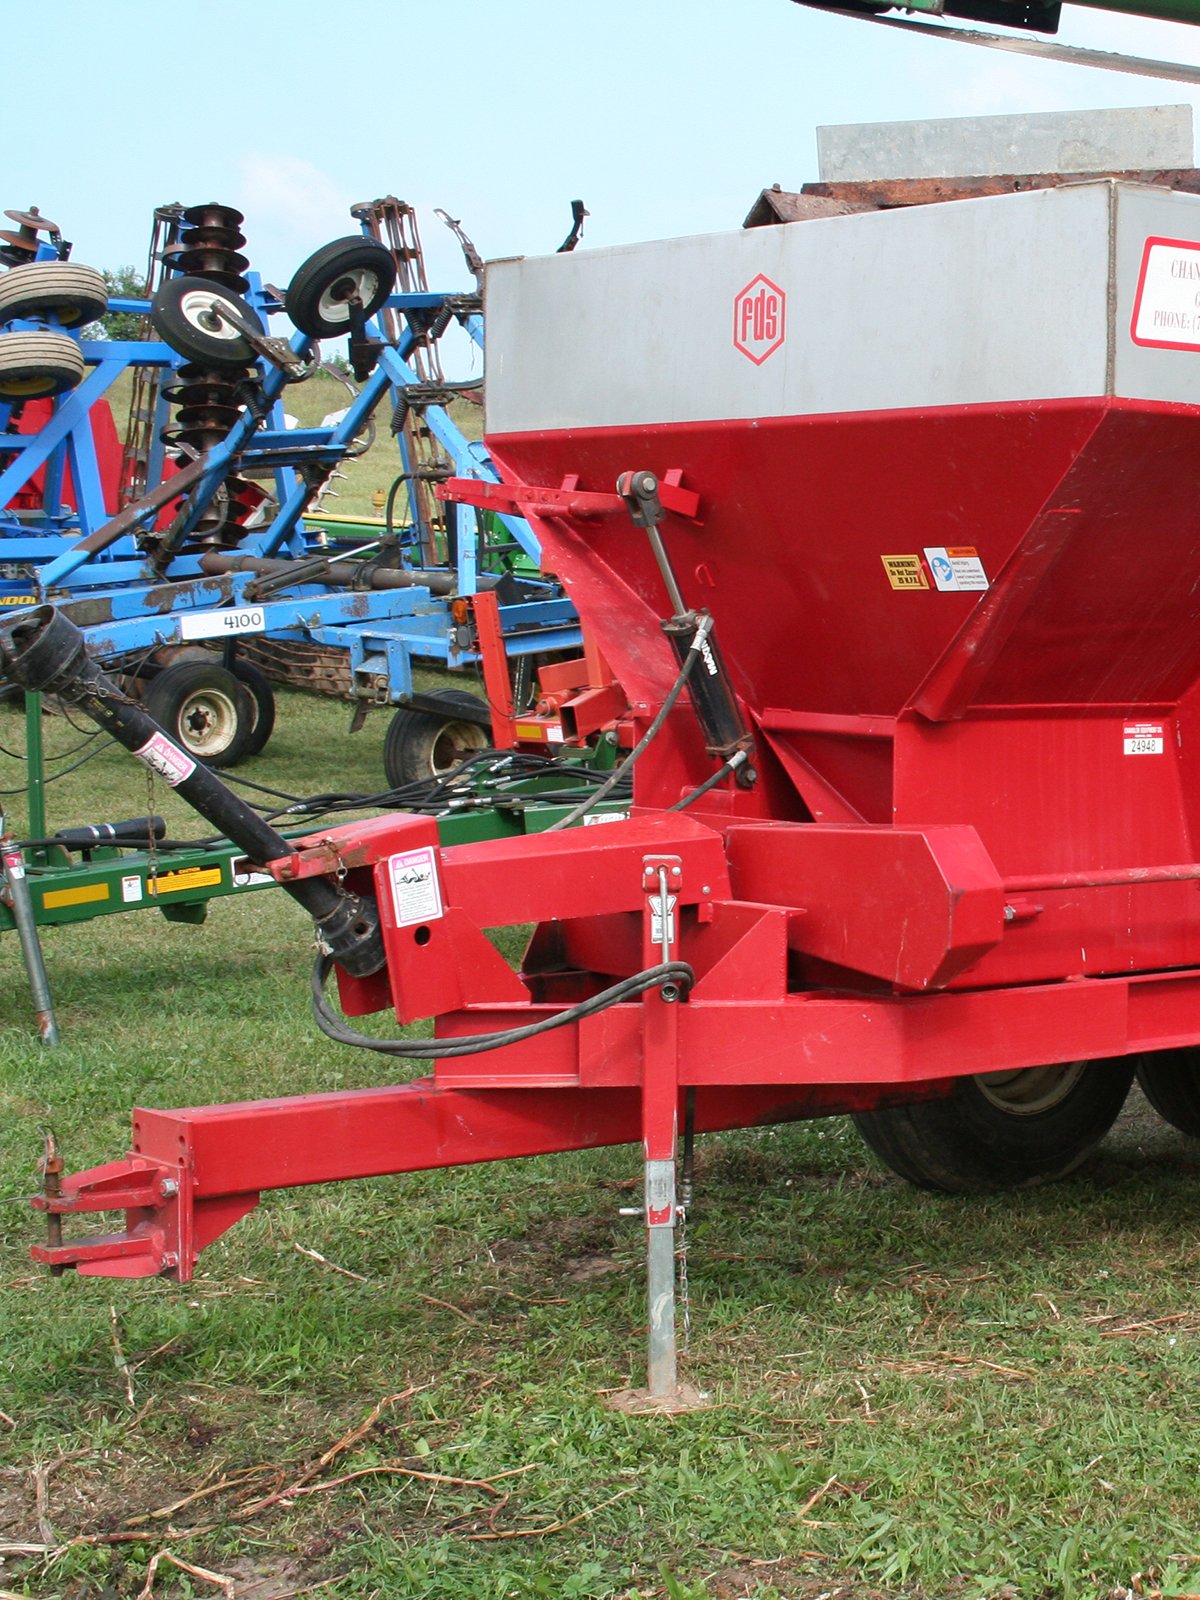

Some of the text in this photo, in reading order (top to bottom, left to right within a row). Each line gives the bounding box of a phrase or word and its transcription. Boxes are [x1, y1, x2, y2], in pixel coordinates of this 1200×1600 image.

[1153, 310, 1190, 329] PHONE:
[224, 612, 262, 629] 4100
[1131, 740, 1156, 752] 24948
[163, 747, 188, 772] DANGER
[404, 854, 428, 866] DANGER
